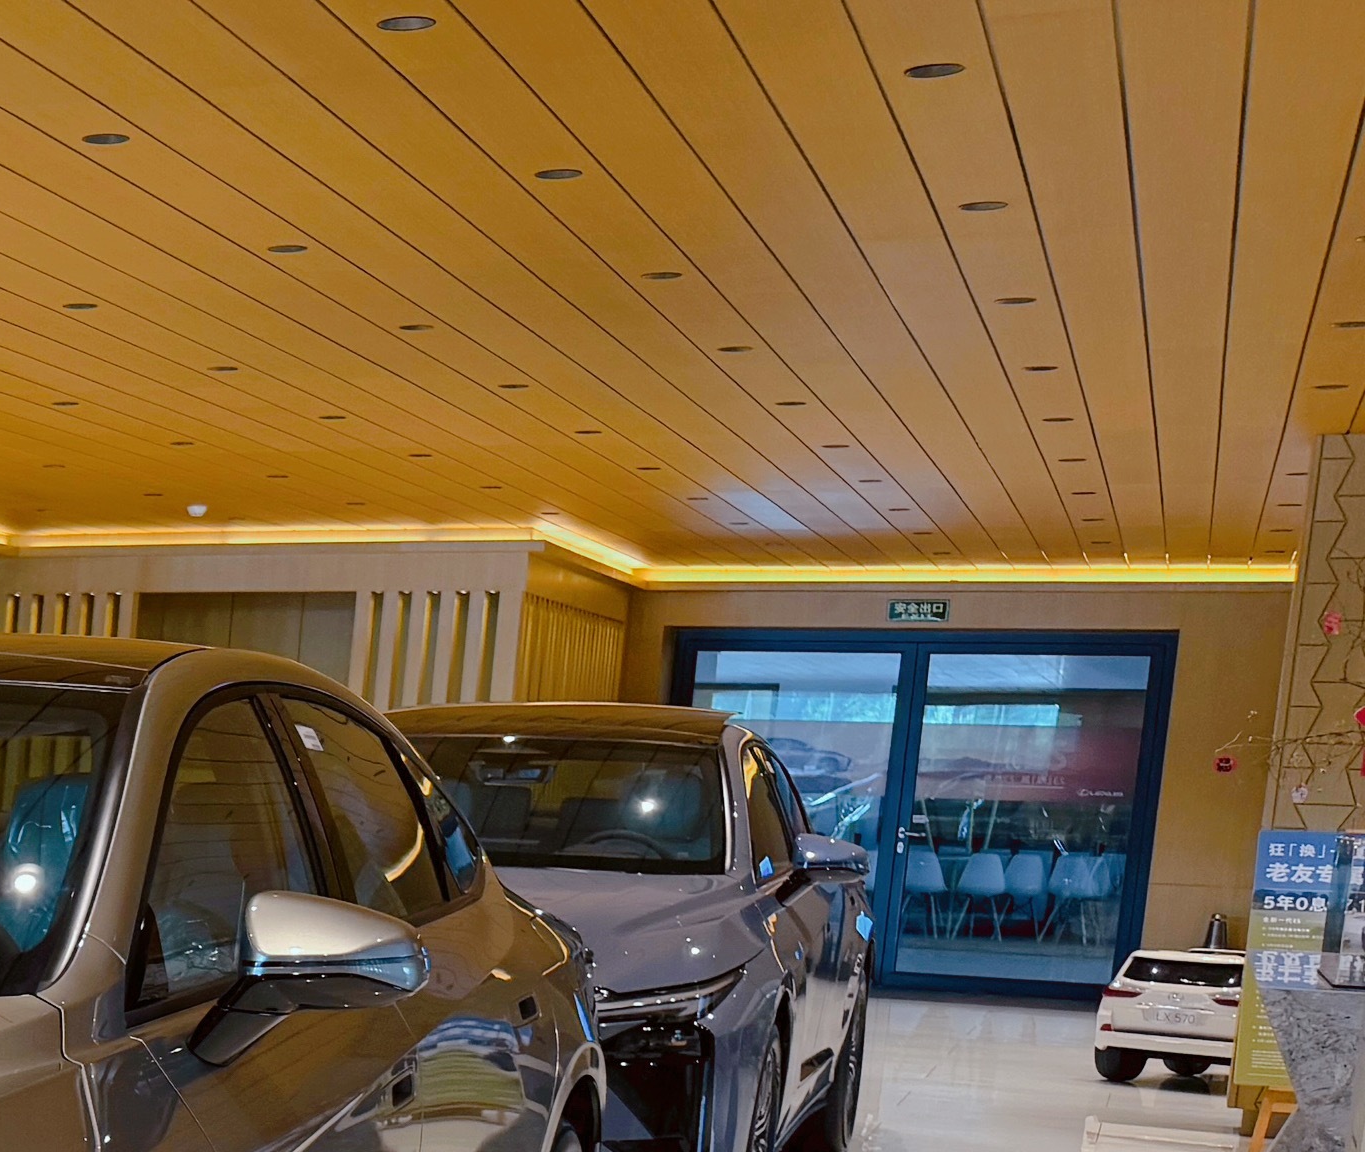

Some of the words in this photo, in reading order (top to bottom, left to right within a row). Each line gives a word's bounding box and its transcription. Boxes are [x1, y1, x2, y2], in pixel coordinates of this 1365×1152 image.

[894, 602, 944, 614] 安全出口
[1174, 1013, 1196, 1025] 570
